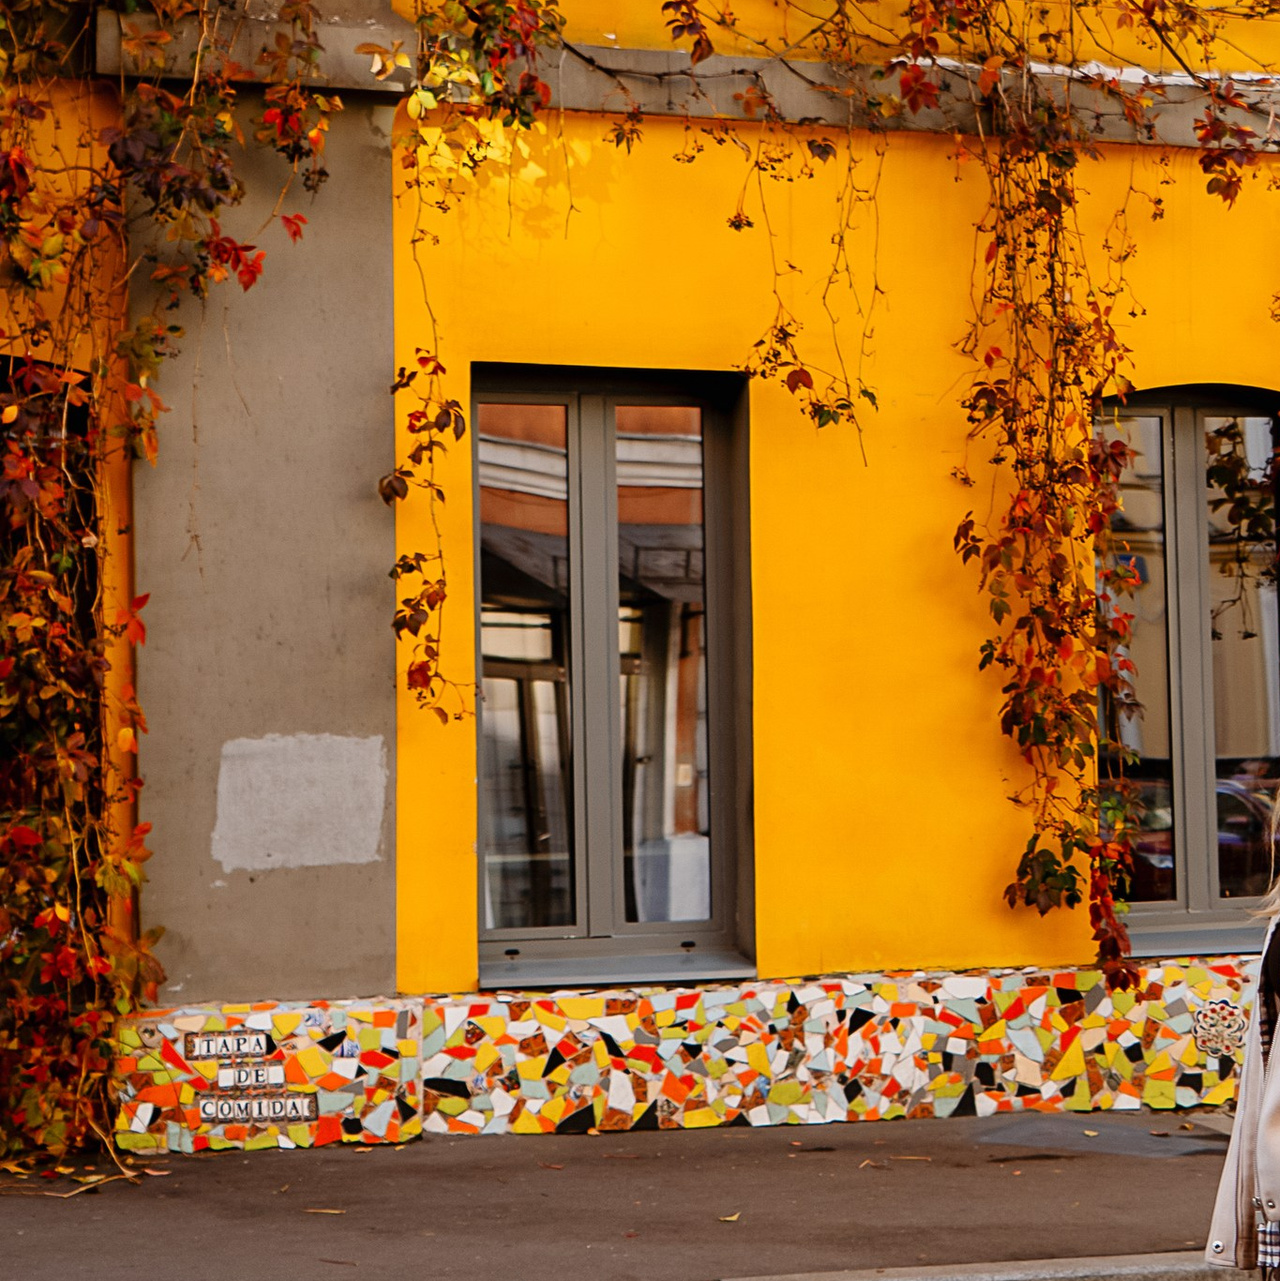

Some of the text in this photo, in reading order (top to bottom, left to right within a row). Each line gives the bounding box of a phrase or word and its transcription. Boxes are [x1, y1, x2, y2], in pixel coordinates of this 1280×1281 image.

[202, 1037, 264, 1054] TAPA
[237, 1069, 266, 1084] DE
[201, 1101, 300, 1116] COMIDA
